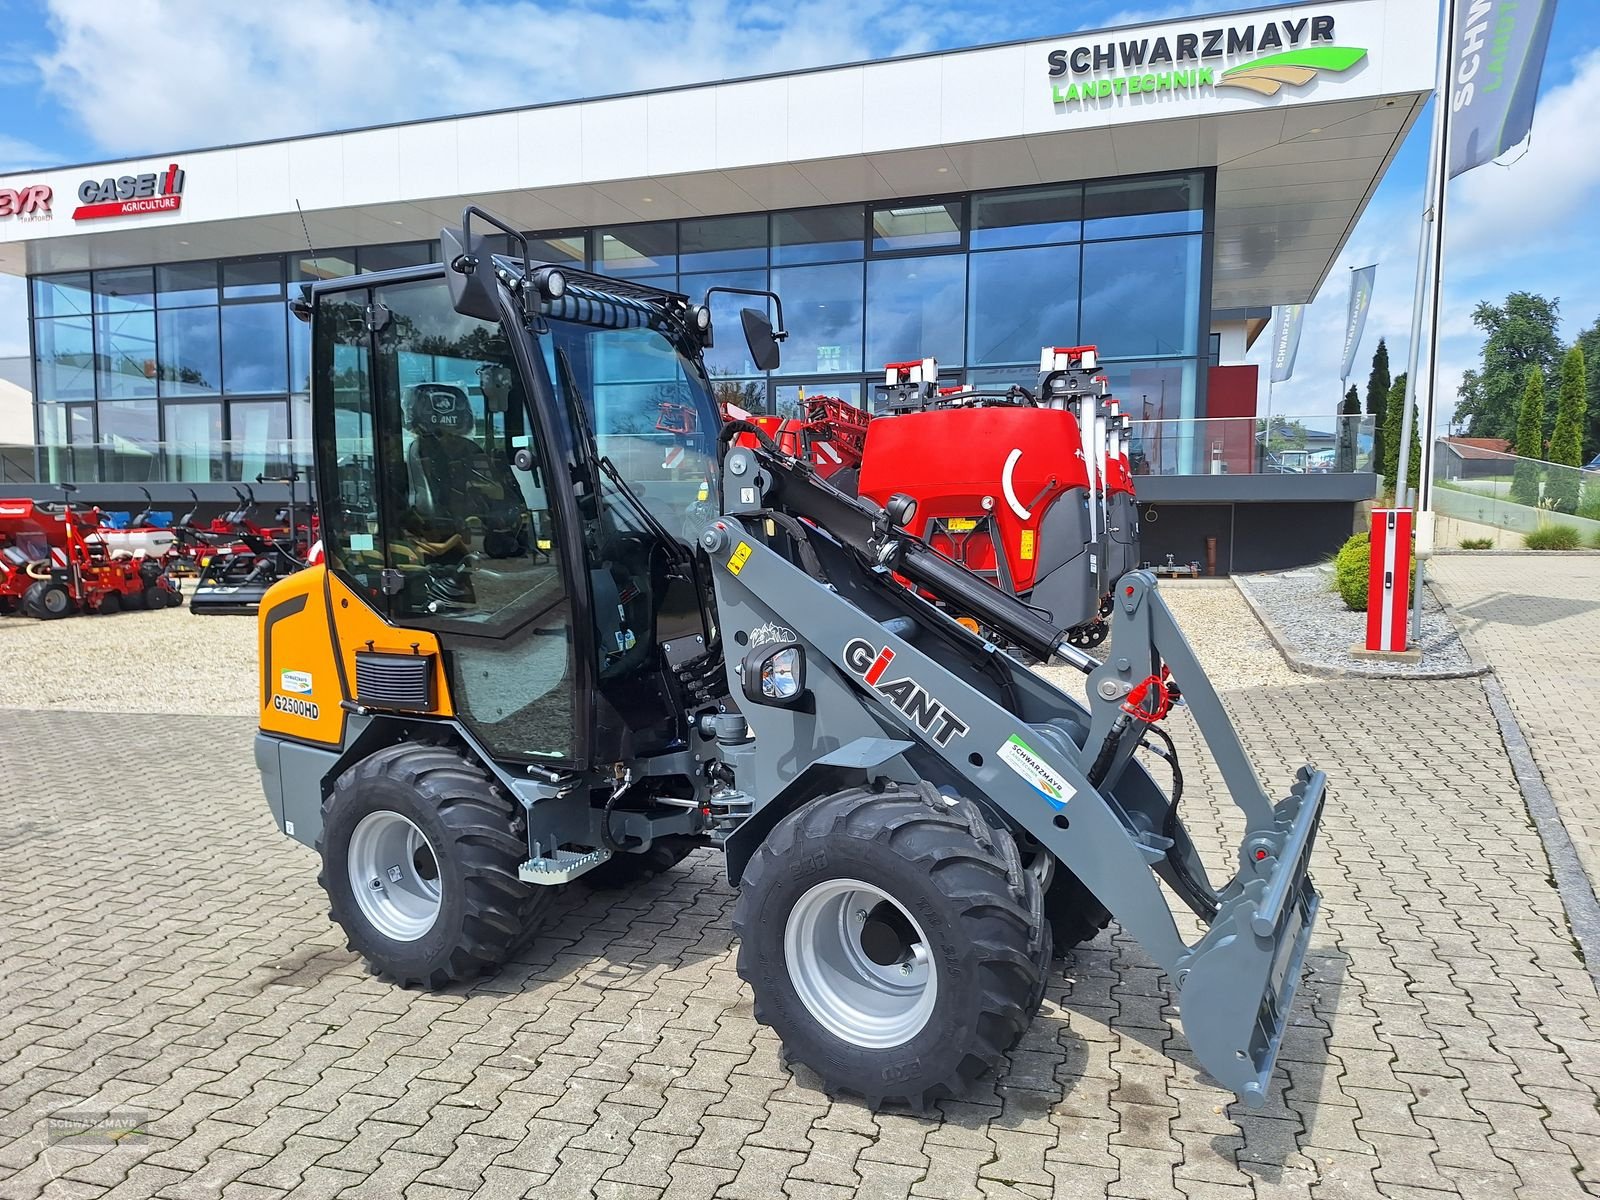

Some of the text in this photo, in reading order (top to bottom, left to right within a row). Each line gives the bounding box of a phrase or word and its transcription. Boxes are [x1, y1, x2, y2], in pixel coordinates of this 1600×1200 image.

[1047, 15, 1336, 77] SCHWARZMAYR
[1453, 0, 1492, 113] SCHW
[1052, 66, 1216, 104] LANDTECHNIK
[78, 173, 157, 204] CASE
[121, 197, 176, 213] AGRICULTURE
[431, 415, 458, 424] GANT
[274, 695, 319, 720] G2500HD
[1012, 744, 1063, 791] SCHWARZMAYR
